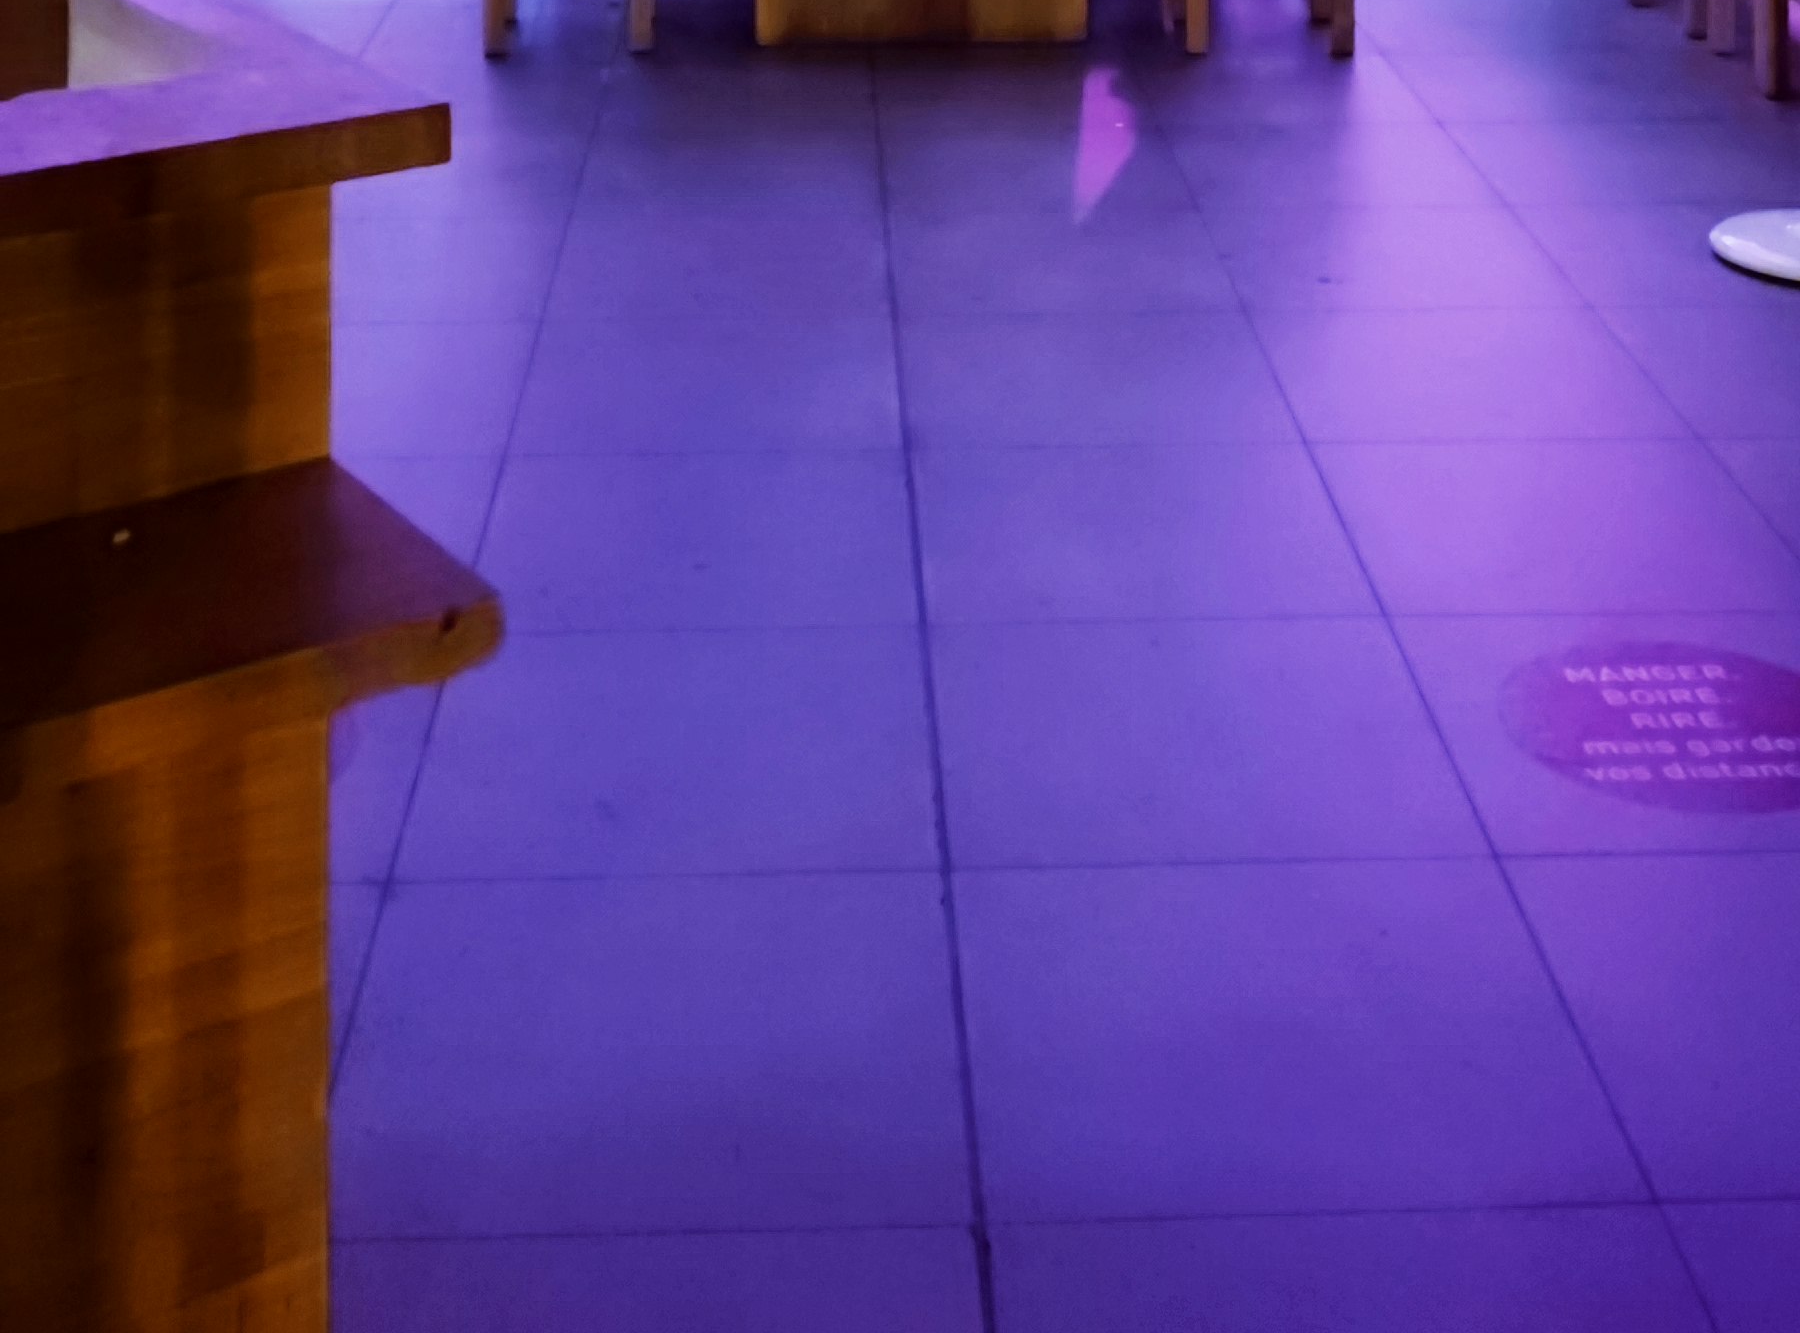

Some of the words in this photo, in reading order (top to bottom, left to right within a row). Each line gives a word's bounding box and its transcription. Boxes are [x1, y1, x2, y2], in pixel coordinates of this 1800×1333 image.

[1582, 739, 1677, 755] mais
[1686, 734, 1800, 758] garde
[1584, 764, 1653, 782] vos
